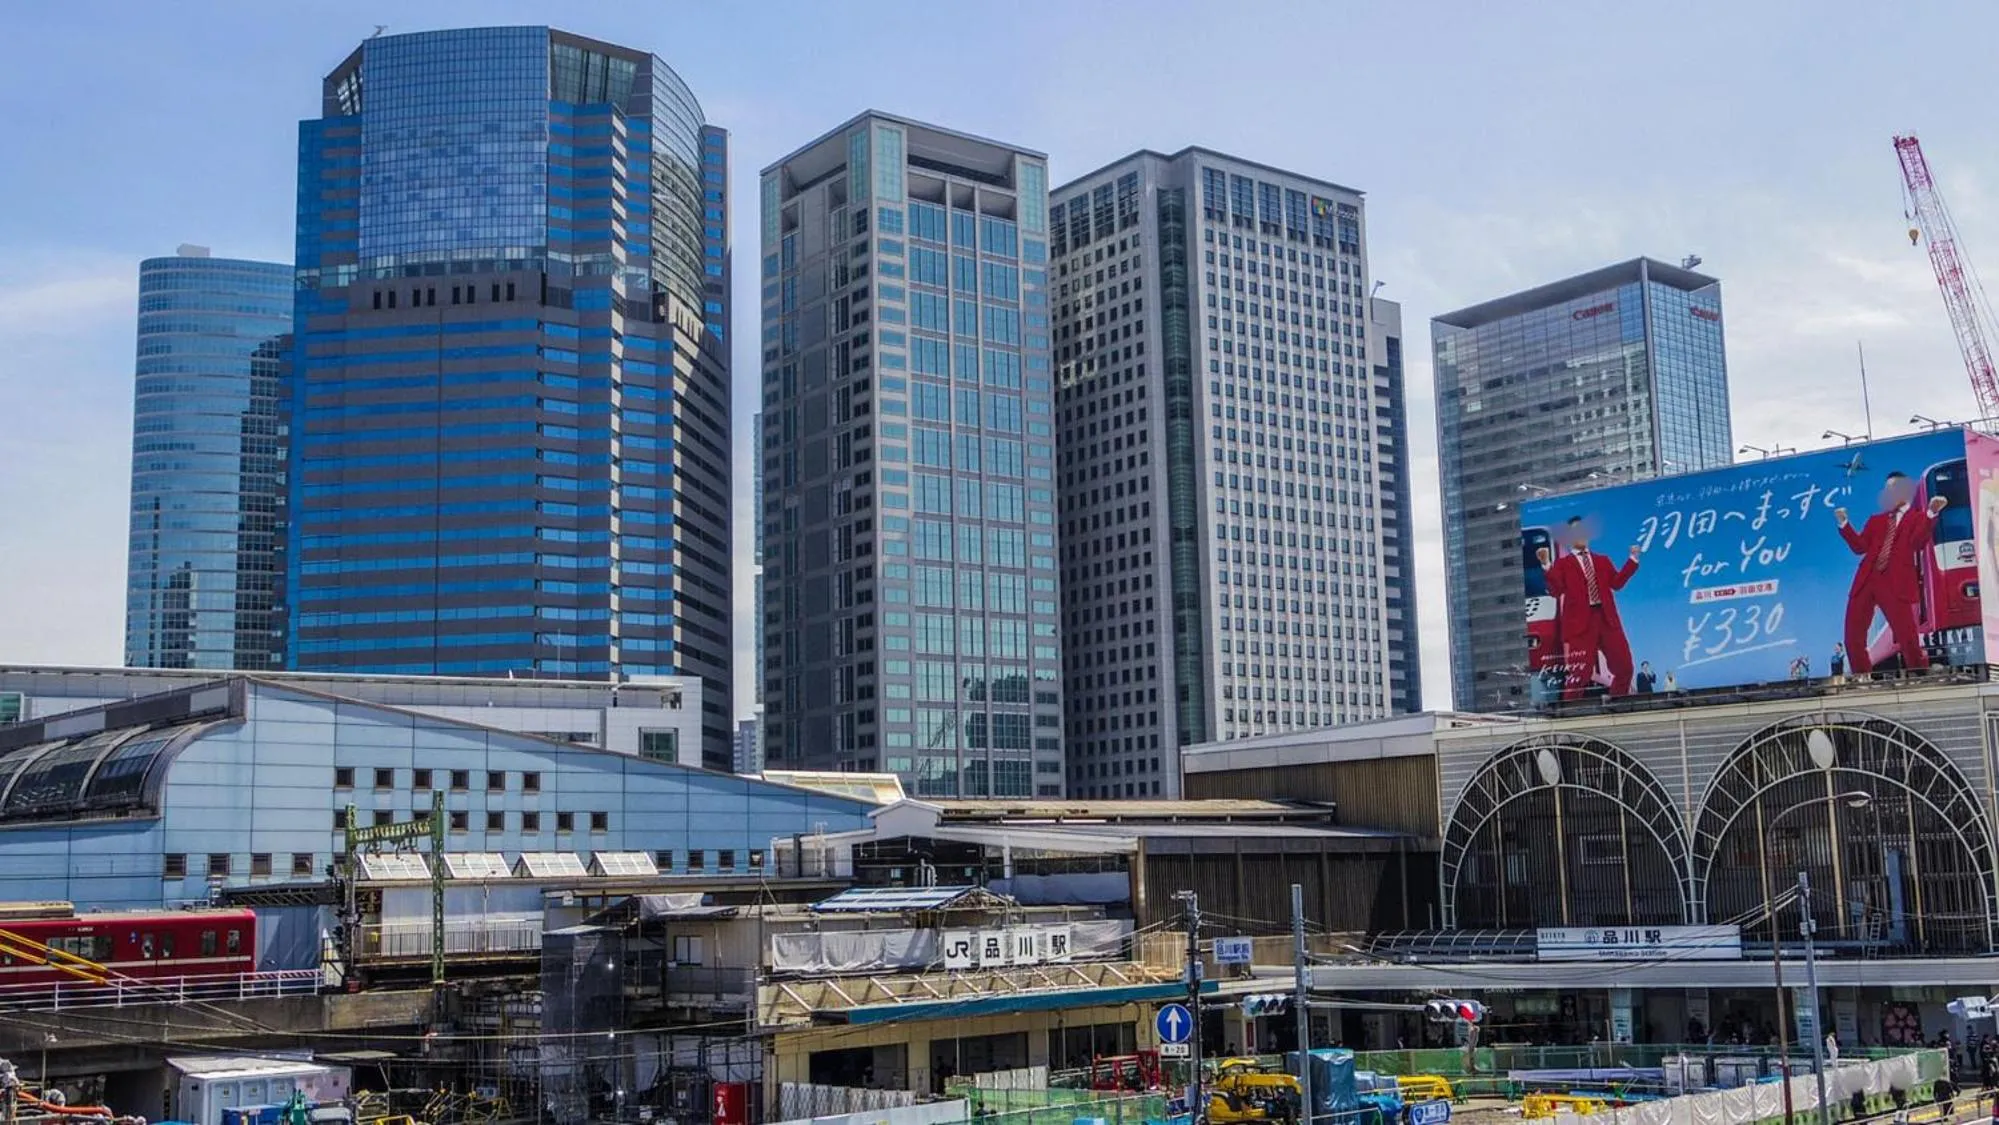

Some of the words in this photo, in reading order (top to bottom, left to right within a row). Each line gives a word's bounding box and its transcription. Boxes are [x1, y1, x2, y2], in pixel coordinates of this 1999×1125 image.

[1637, 484, 1852, 553] 羽田へまっすぐ
[1682, 553, 1729, 588] for
[1683, 602, 1784, 661] ¥330
[1919, 628, 1974, 647] KEIKYU
[1602, 930, 1661, 944] 品川駅
